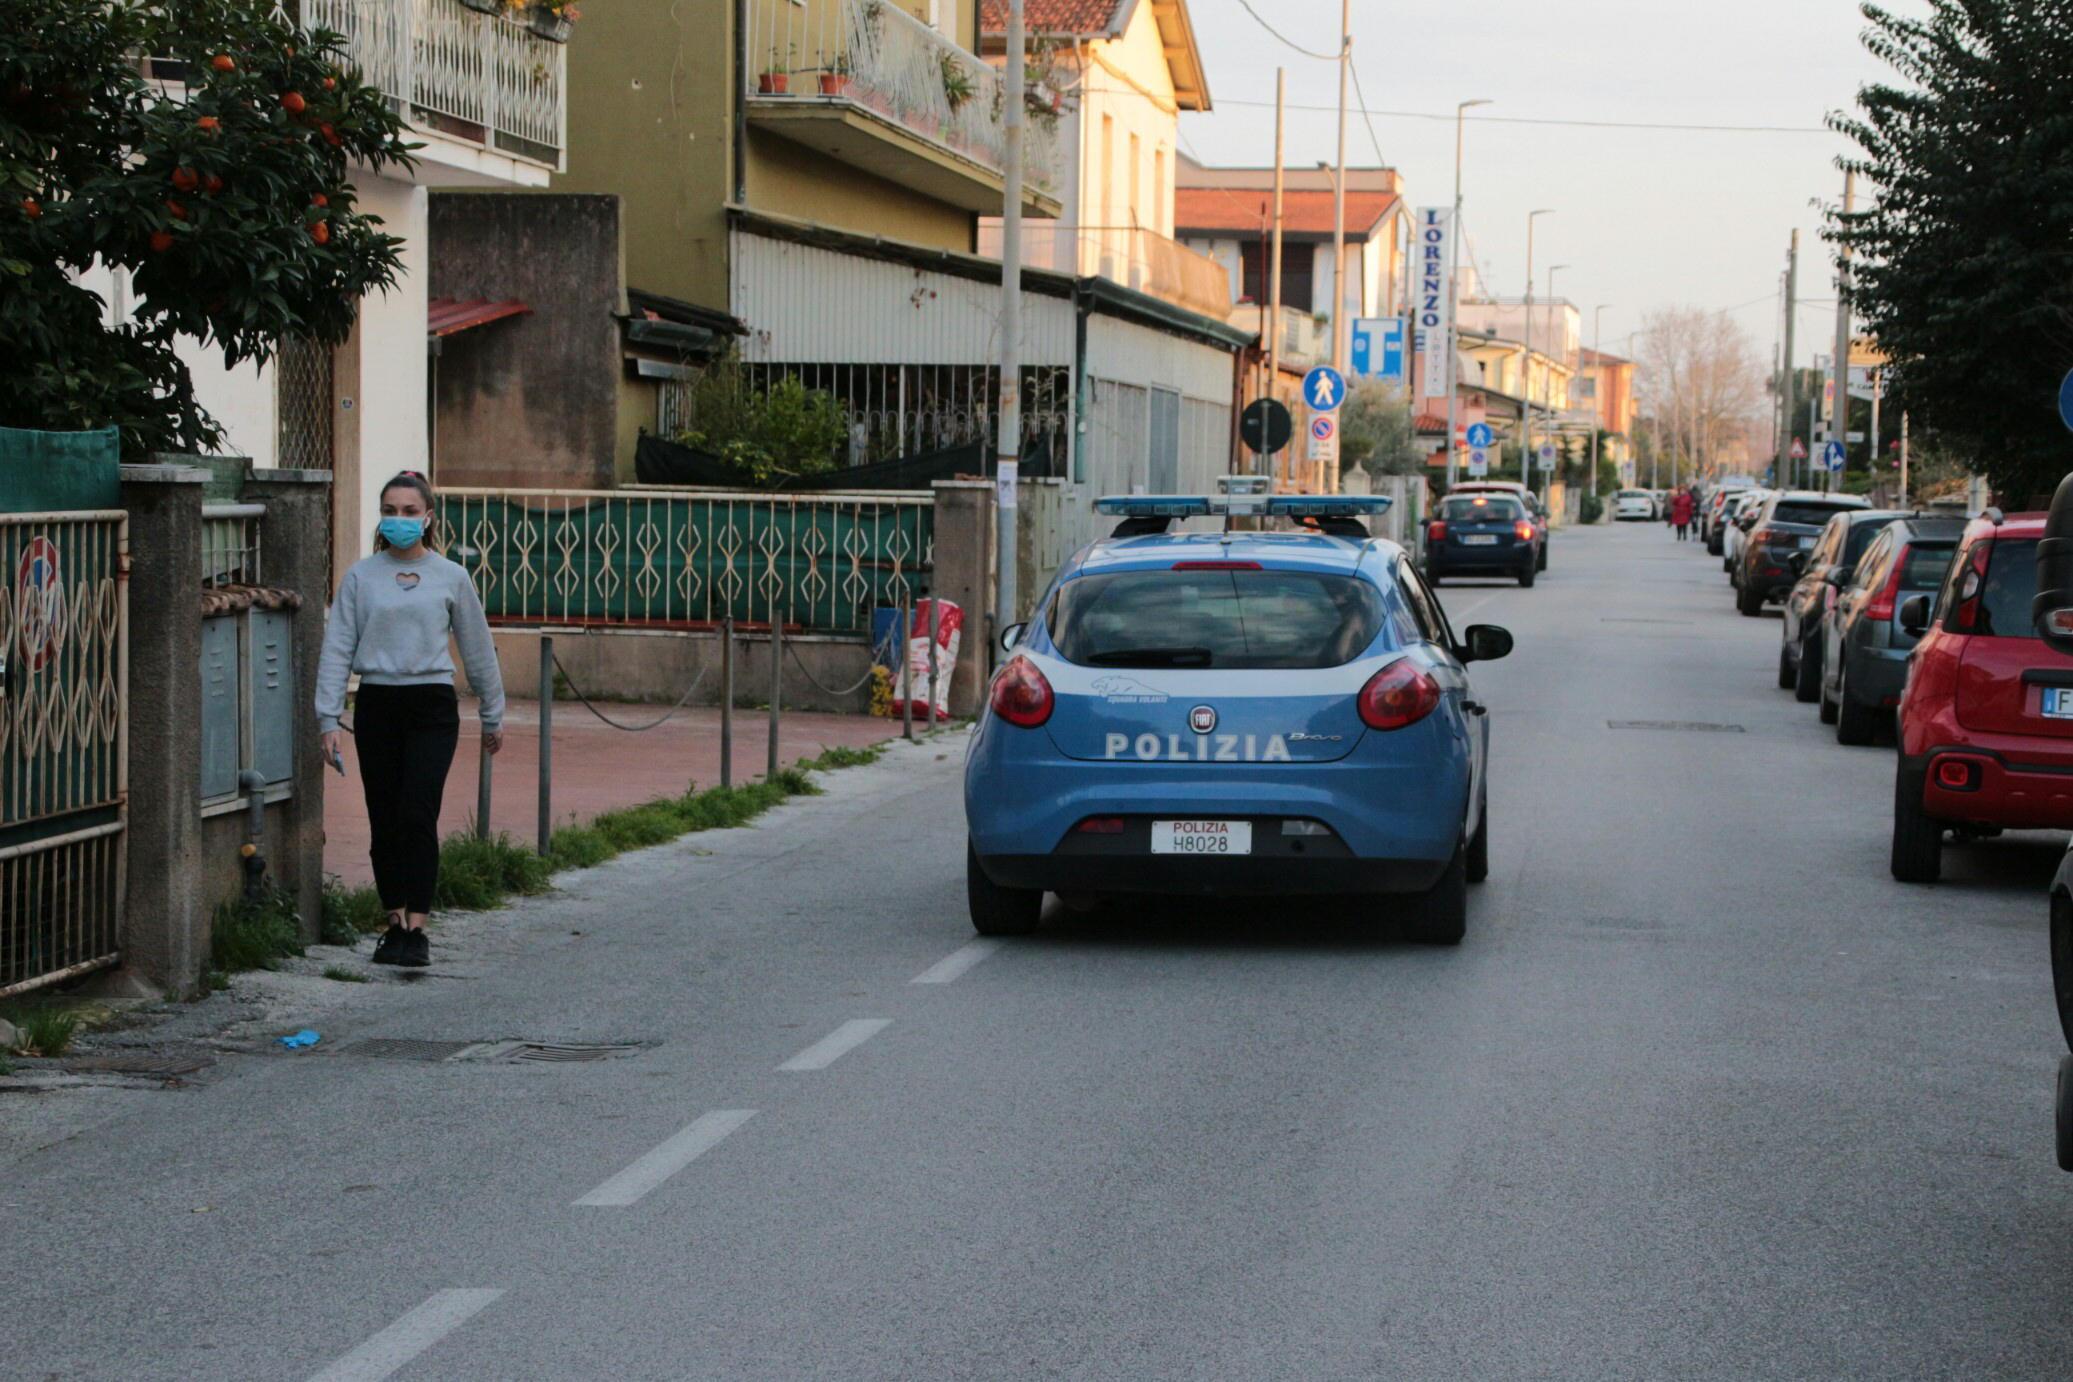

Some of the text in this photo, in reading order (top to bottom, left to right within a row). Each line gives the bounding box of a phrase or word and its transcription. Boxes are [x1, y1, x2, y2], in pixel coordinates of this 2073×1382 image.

[1422, 209, 1442, 327] LORENZO
[2059, 690, 2071, 711] F
[1194, 713, 1211, 726] FIAT
[1105, 733, 1292, 761] POLIZIA
[1173, 822, 1228, 834] POLIZIA
[1173, 836, 1228, 852] H8028
